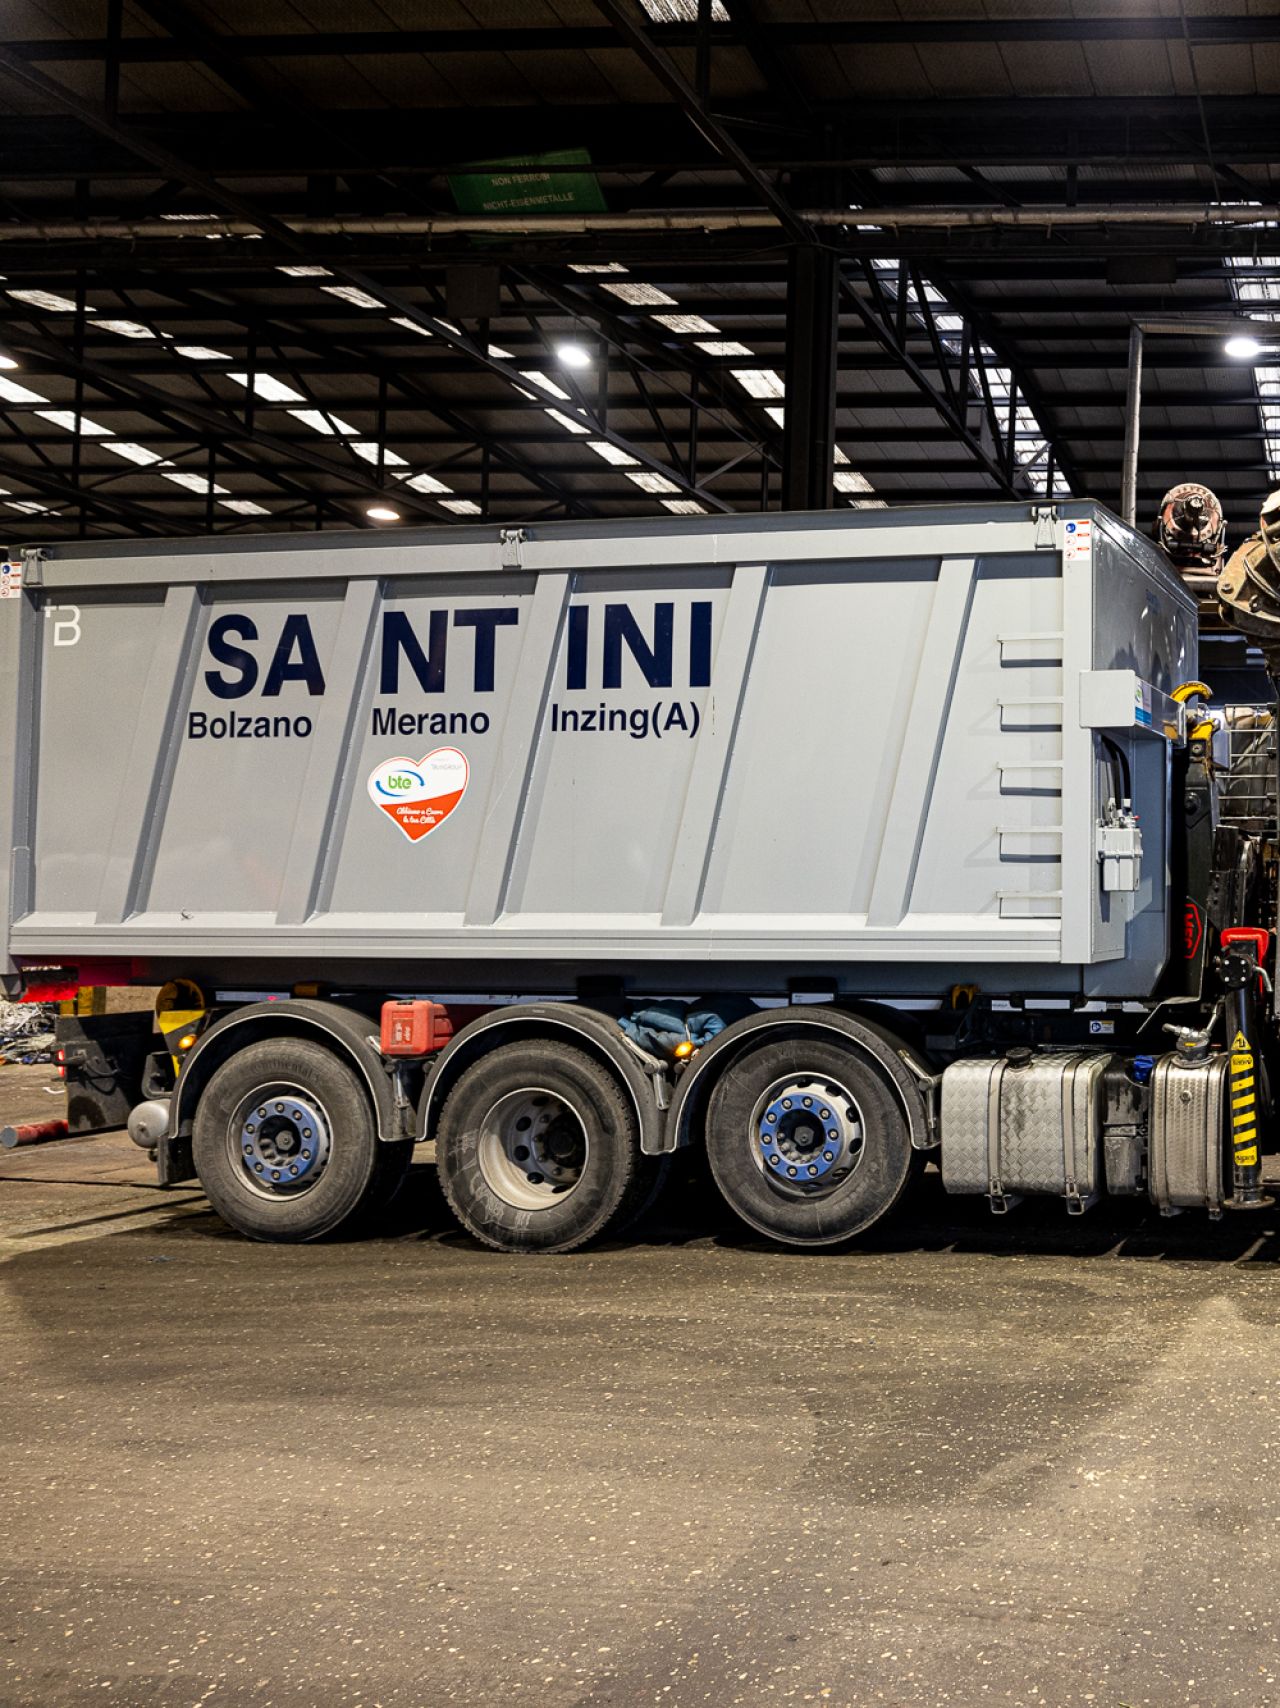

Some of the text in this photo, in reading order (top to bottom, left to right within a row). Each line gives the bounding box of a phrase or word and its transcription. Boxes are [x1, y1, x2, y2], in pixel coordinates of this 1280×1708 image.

[491, 178, 511, 186] NON
[187, 711, 312, 739] Bolzano
[372, 706, 490, 735] Merano
[551, 701, 701, 739] Inzing(A)
[388, 775, 412, 789] bte
